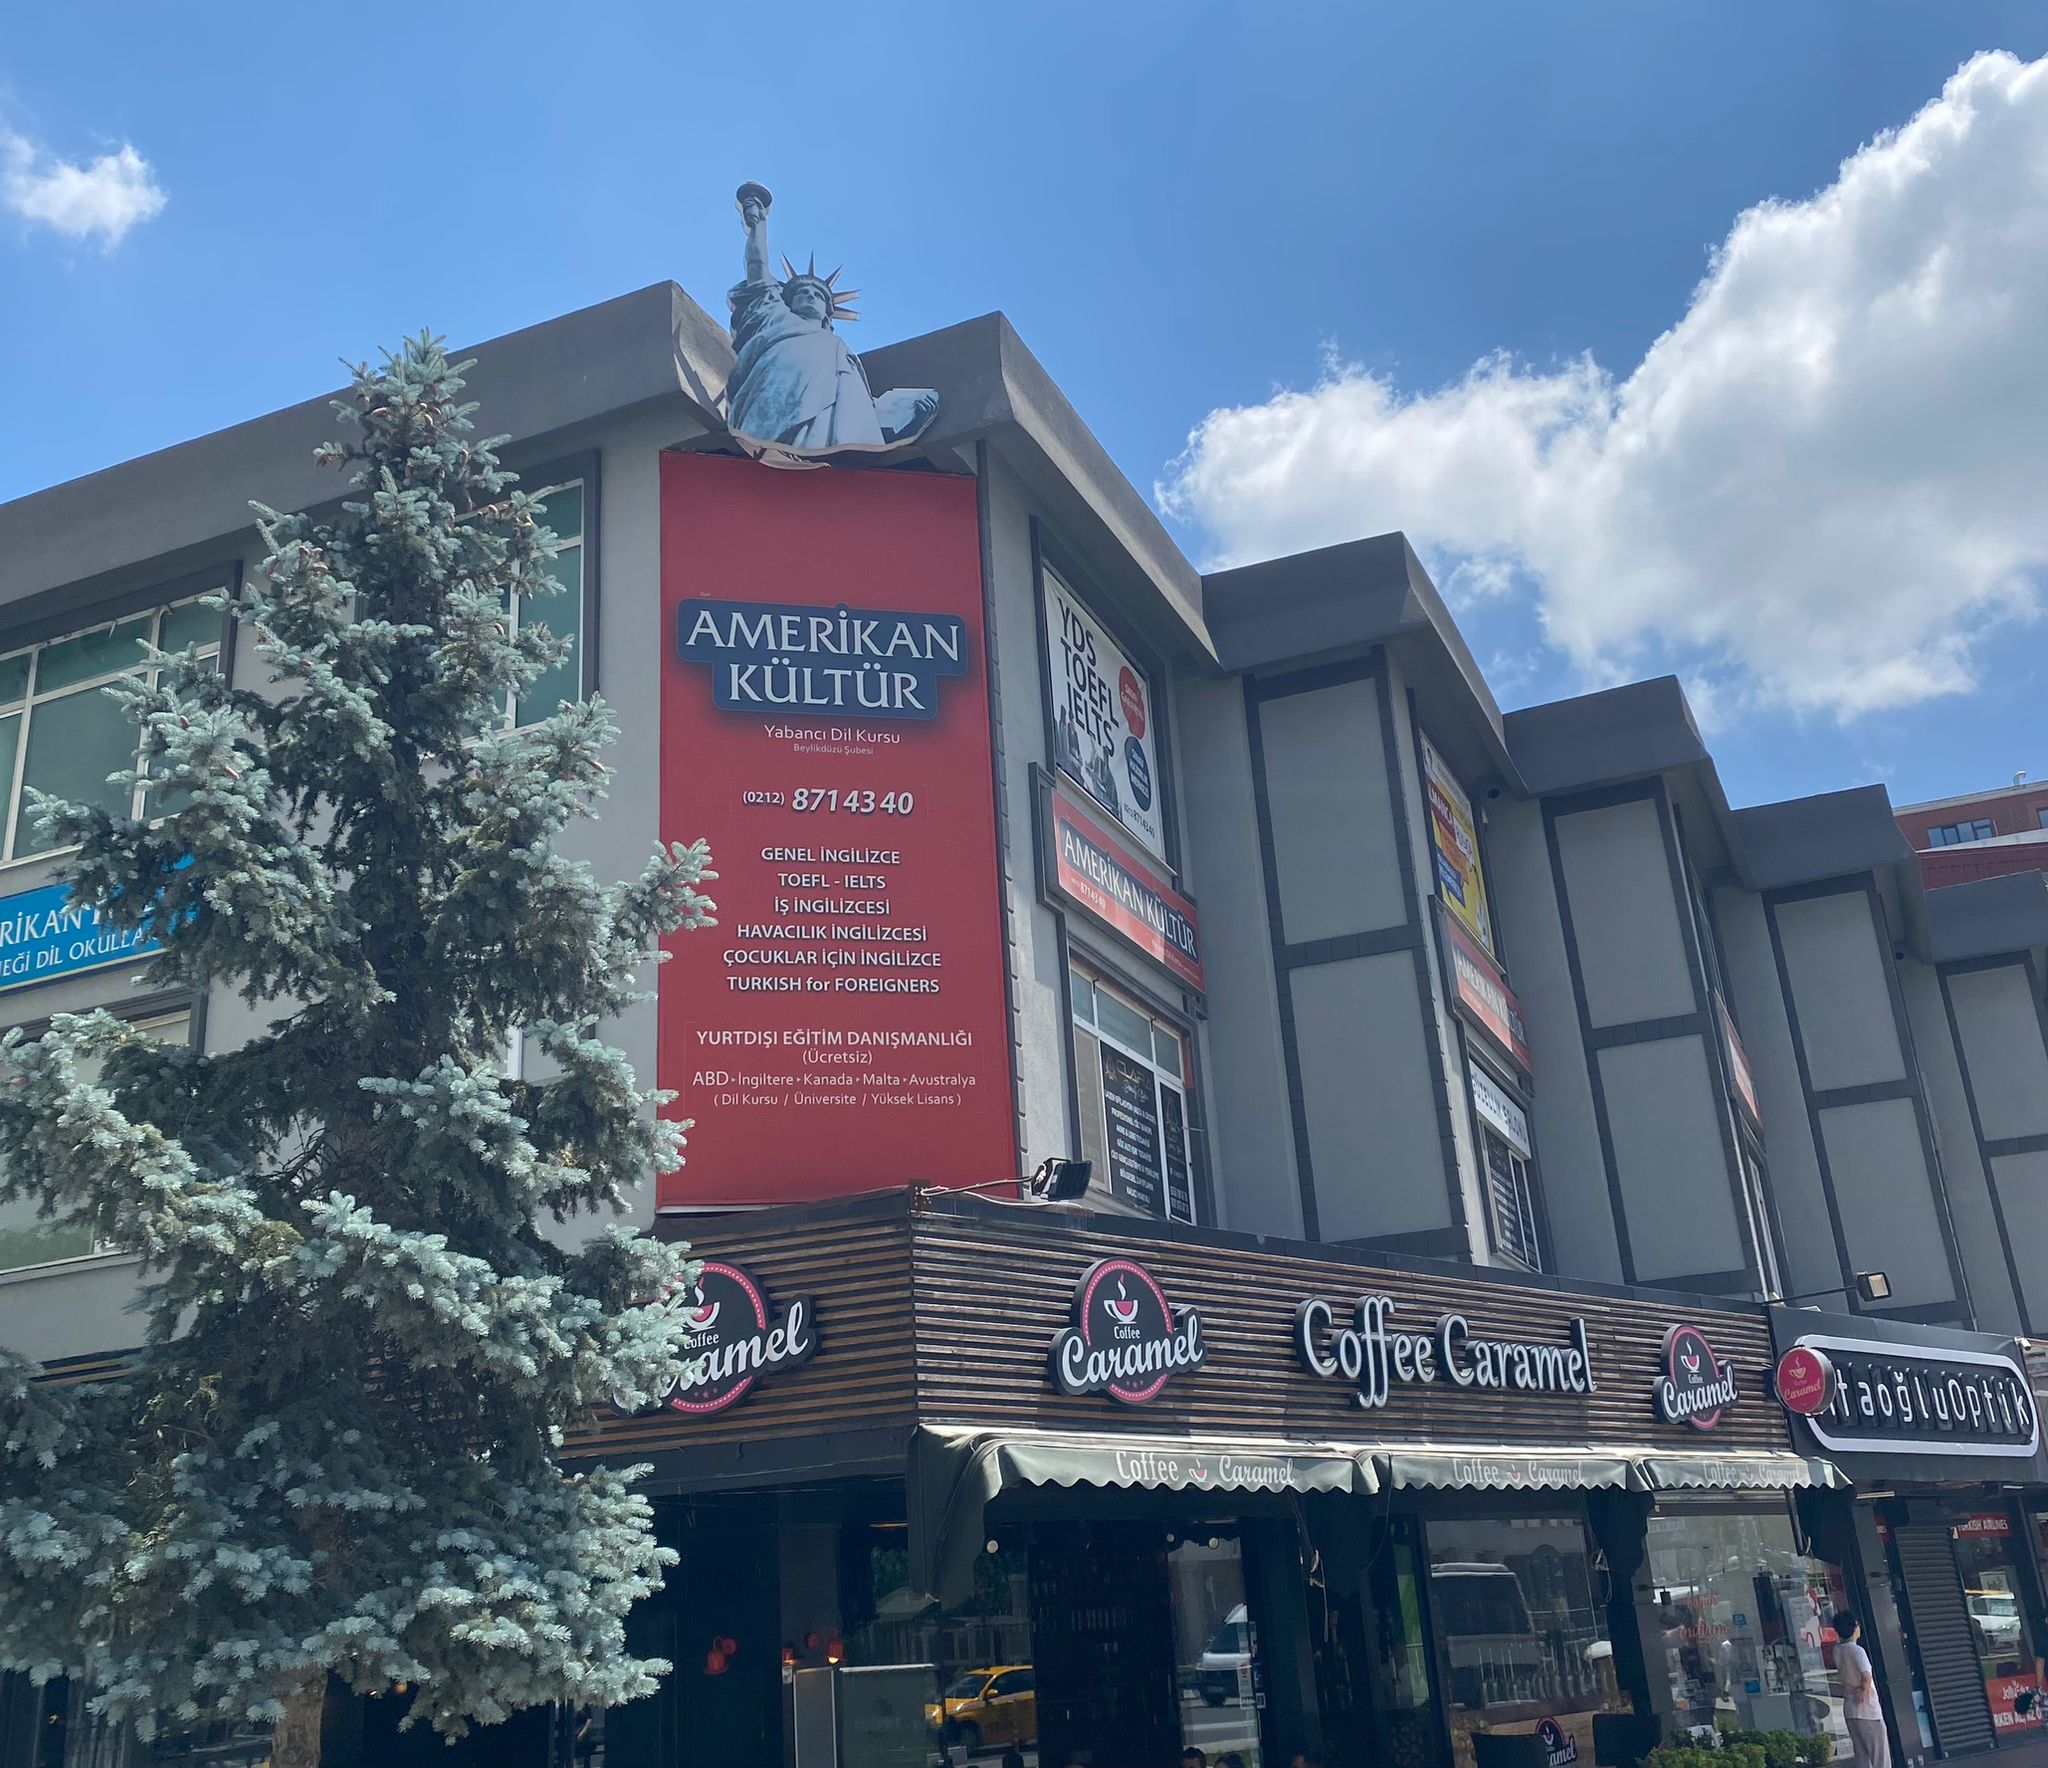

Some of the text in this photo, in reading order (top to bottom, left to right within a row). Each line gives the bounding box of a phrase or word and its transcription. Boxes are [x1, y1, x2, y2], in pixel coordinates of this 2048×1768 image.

[686, 609, 960, 662] AMERİKAN
[1058, 597, 1096, 667] YDS
[729, 656, 926, 710] KÜLTÜR
[1060, 637, 1120, 729] TOEFL
[1067, 681, 1115, 758] IELTS
[764, 725, 901, 744] Yabancı Dil Kursu
[742, 791, 785, 806] (0212)
[761, 846, 901, 864] GENEL İNGİLİZCE
[777, 873, 830, 888] TOEFL
[845, 874, 886, 889] IELTS
[1064, 829, 1197, 958] AMERİKAN KÜLTÜR
[774, 896, 890, 915] İŞ İNGİLİZCESİ
[738, 923, 927, 941] HAVACILIK İNGİLİZCESİ
[36, 944, 63, 969] DİL
[723, 948, 941, 968] ÇOCUKLAR İÇİN İNGİLİZCE
[727, 976, 940, 993] TURKISH for FOREIGNERS
[697, 1028, 972, 1049] YURTDIŞI EĞİTİM DANIŞMANLIĞI
[802, 1050, 873, 1065] (Ücretsiz)
[692, 1071, 729, 1086] ABD
[804, 1073, 853, 1086] Kanada
[863, 1073, 900, 1086] Malta
[909, 1073, 976, 1088] Avustralya
[742, 1094, 778, 1105] Kursu
[794, 1091, 857, 1105] Üniversite
[872, 1093, 914, 1105] Yüksek
[1114, 1326, 1141, 1340] Coffee
[1062, 1314, 1203, 1387] Caramel
[1302, 1297, 1598, 1409] Coffee Caramel
[1663, 1365, 1738, 1418] Caramel
[1784, 1377, 1822, 1400] Caramel
[1116, 1451, 1295, 1484] Coffee Caramel
[1453, 1459, 1585, 1484] Coffee Caramel
[1546, 1736, 1577, 1766] amel
